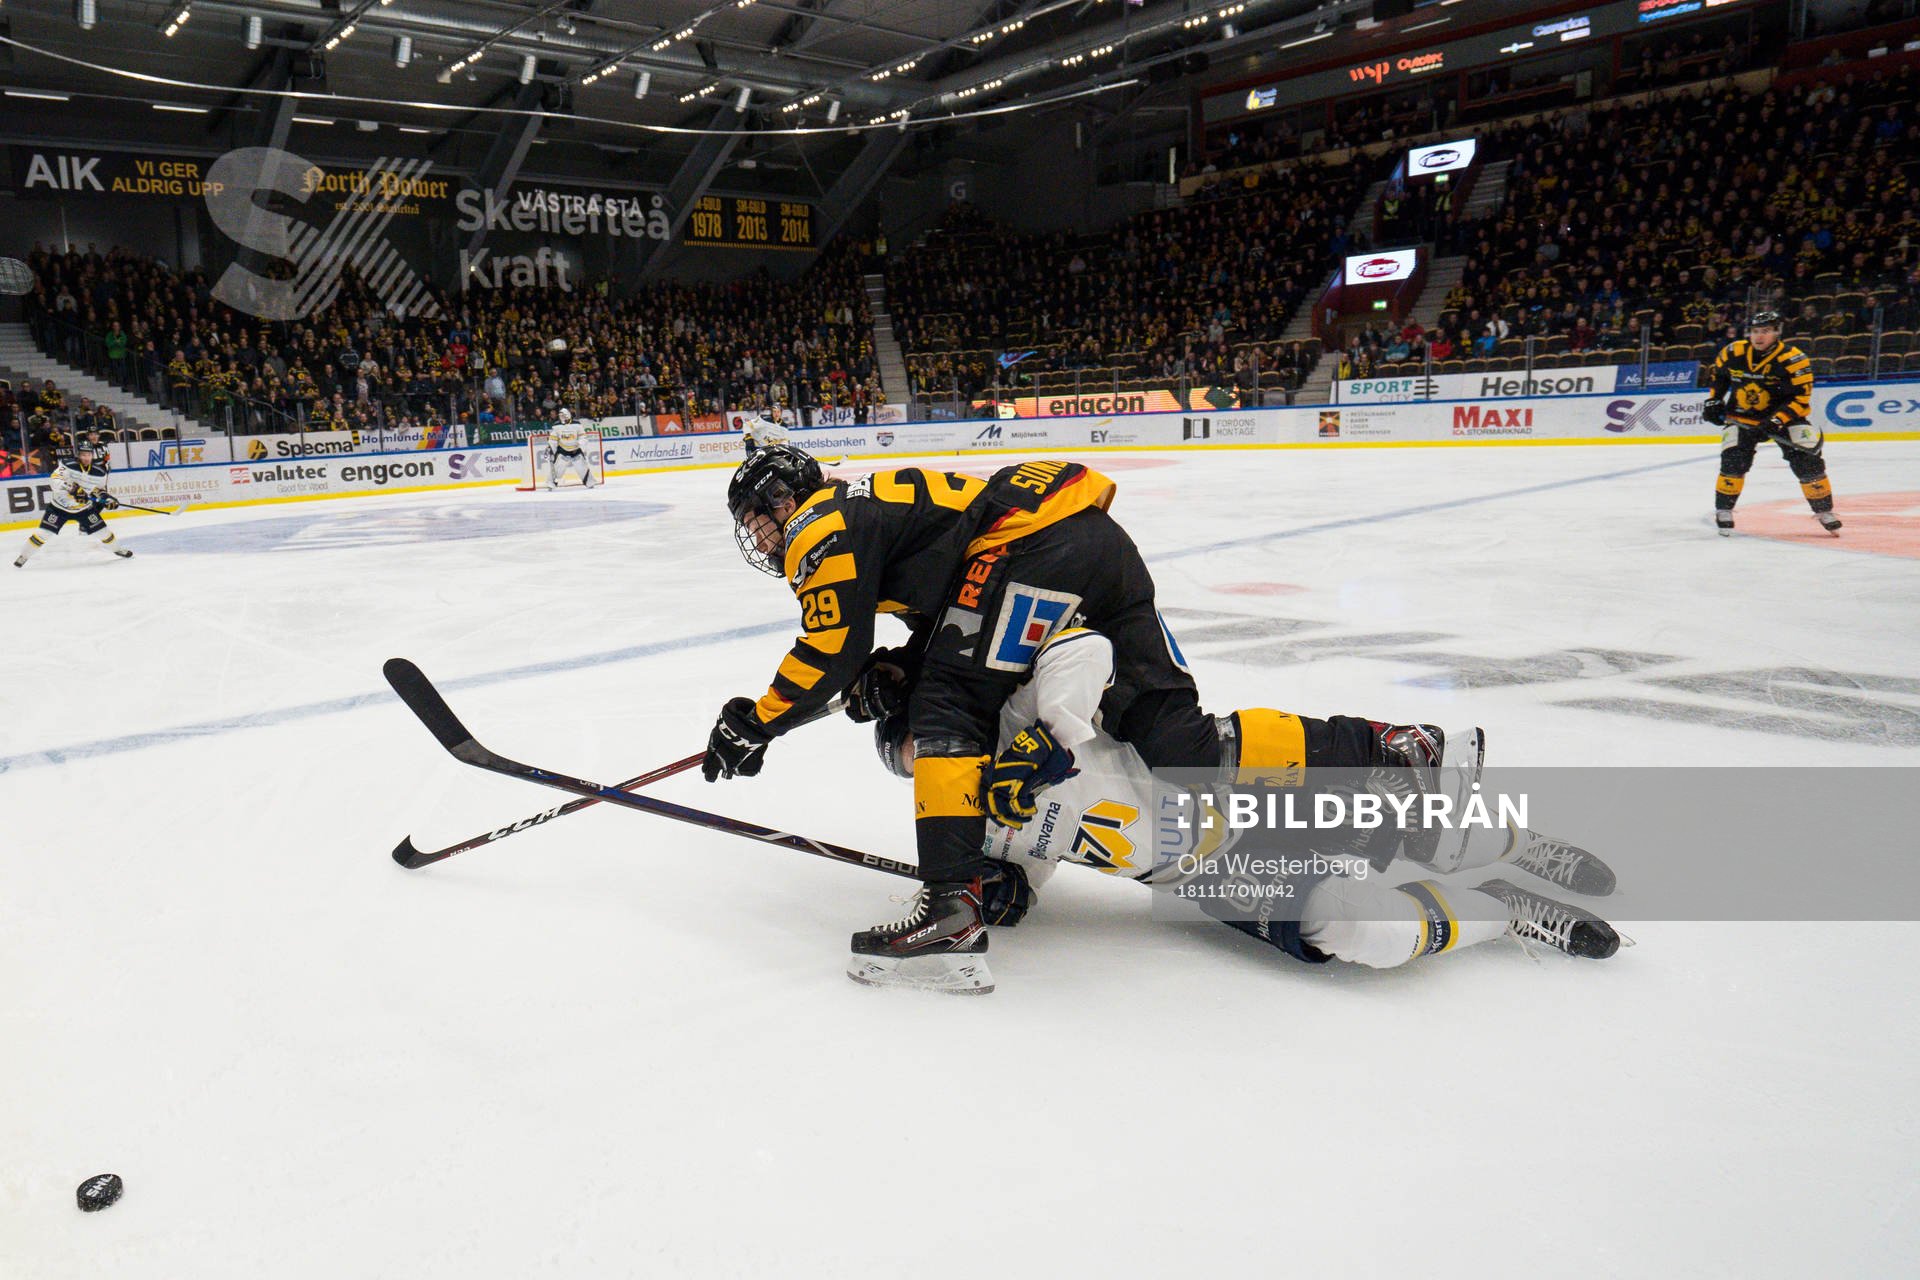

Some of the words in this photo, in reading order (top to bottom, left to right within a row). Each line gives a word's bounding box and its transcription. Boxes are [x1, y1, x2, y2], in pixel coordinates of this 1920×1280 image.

[24, 154, 105, 192] AIK
[135, 160, 155, 177] VI
[159, 162, 200, 179] GER
[112, 177, 185, 196] ALDRIG
[189, 181, 224, 198] UPP
[517, 189, 600, 216] VÄSTRA
[694, 195, 722, 211] -GULD
[691, 211, 723, 239] 1978
[736, 214, 768, 241] 2013
[780, 218, 810, 243] 2014
[459, 246, 573, 293] Kraft
[1350, 379, 1412, 395] SPORT
[1481, 376, 1594, 397] Henson
[1050, 395, 1145, 415] engcon
[1670, 403, 1704, 413] Skell
[1216, 418, 1256, 427] FORDONS
[1453, 406, 1533, 429] MAXI
[361, 432, 424, 444] Homlunds
[1091, 430, 1109, 443] EY
[1216, 427, 1256, 436] MONTAGE
[1467, 428, 1533, 436] STORMARKNAD
[277, 439, 353, 458] Specma
[788, 437, 866, 449] andelsbanken
[485, 452, 523, 464] Skellefteå
[252, 464, 327, 482] valutec
[340, 460, 434, 485] engcon
[485, 463, 505, 473] Kraft
[166, 480, 220, 492] RESOURCES
[754, 470, 773, 490] CCM
[802, 588, 841, 629] 29
[1027, 801, 1062, 861] Husqvarna
[906, 923, 938, 944] CCM
